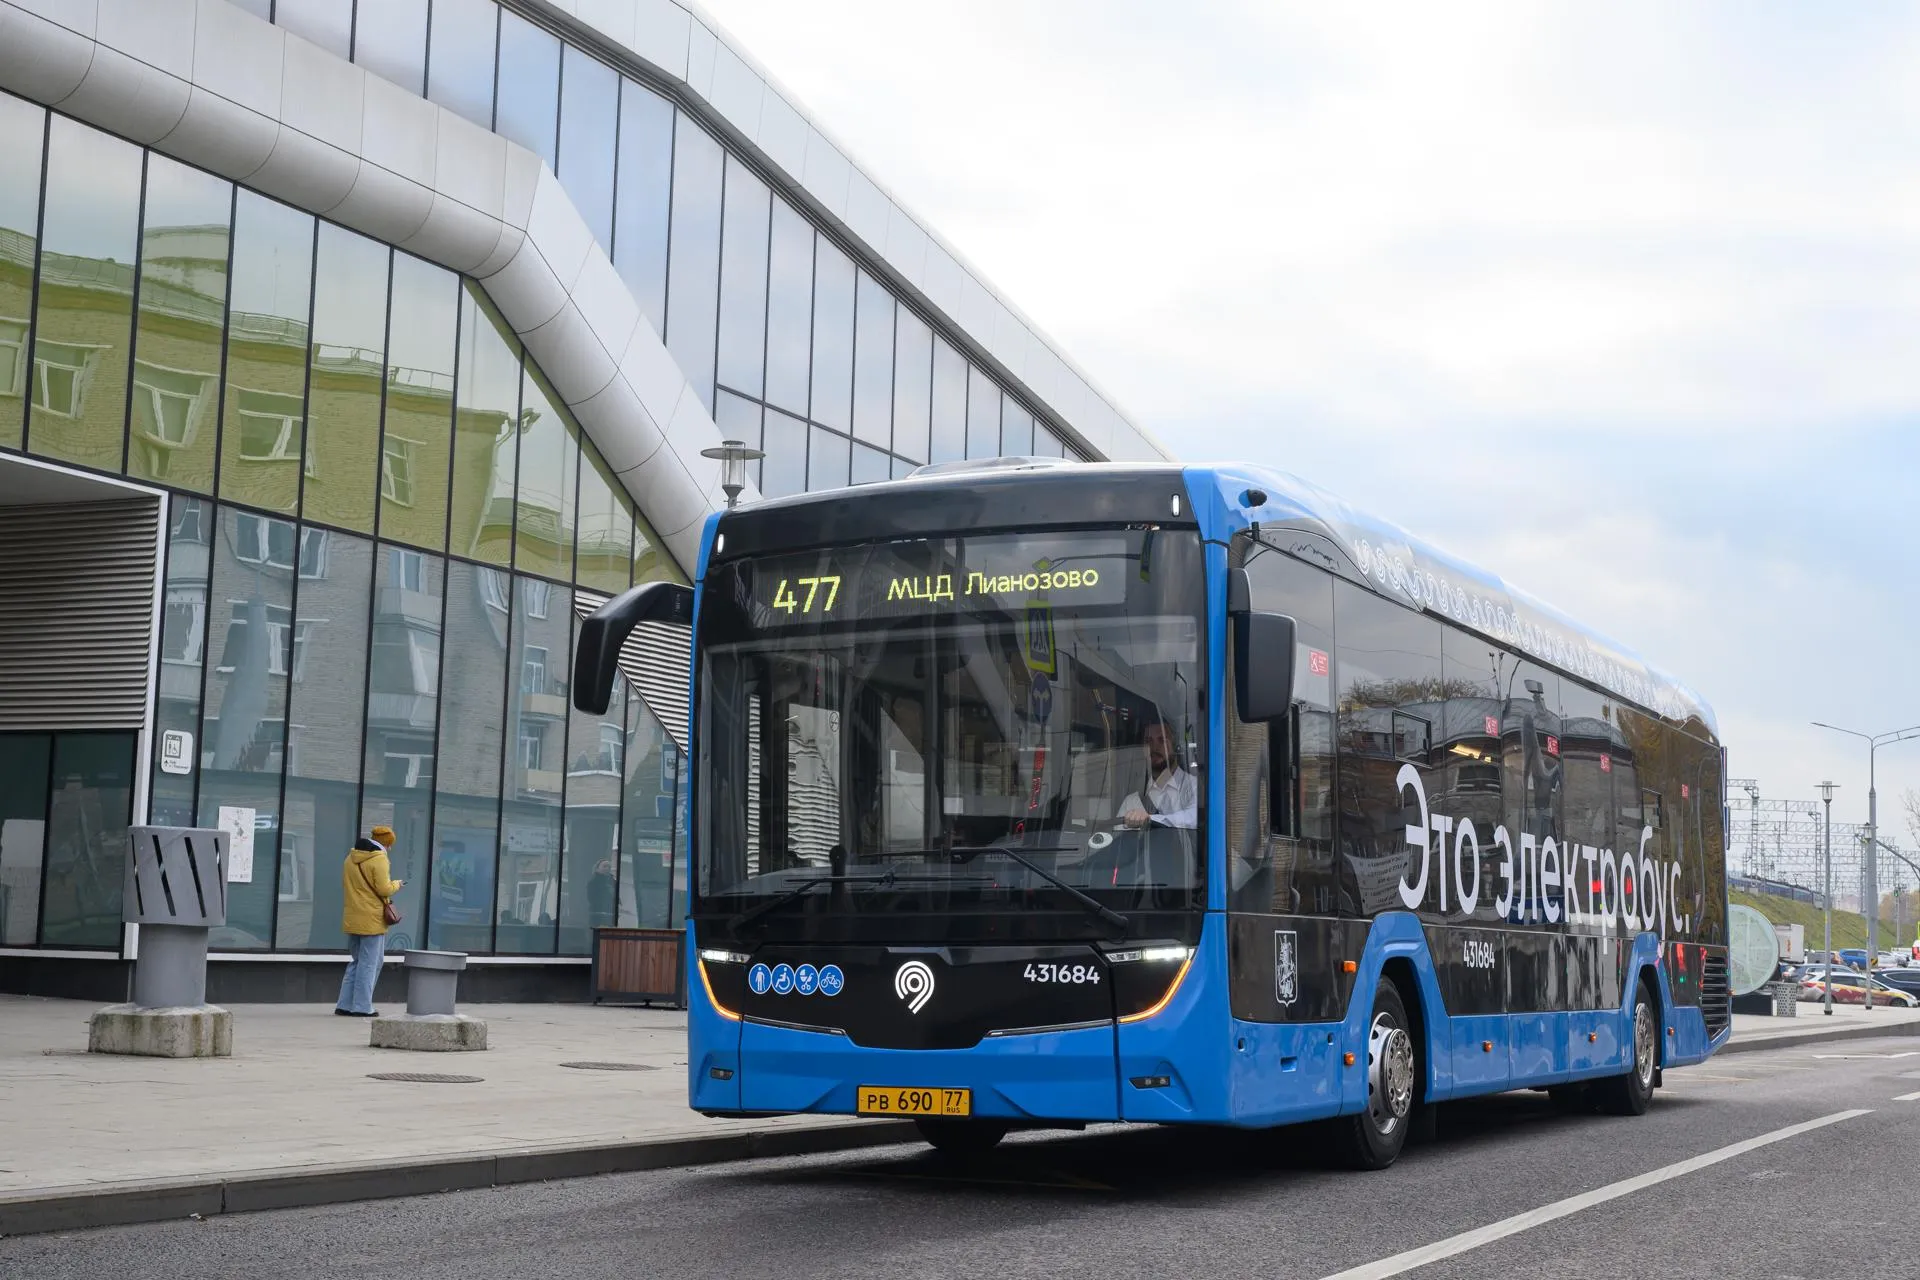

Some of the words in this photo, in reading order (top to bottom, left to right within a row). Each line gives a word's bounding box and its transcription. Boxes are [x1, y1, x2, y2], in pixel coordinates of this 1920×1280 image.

[773, 576, 841, 614] 477
[887, 574, 954, 602] МЦД
[964, 569, 1098, 595] Лианозово
[1396, 763, 1480, 915] Это
[1494, 825, 1690, 958] электробус.
[1463, 940, 1495, 968] 431684
[1023, 963, 1100, 984] 431684
[898, 1090, 932, 1111] 690
[944, 1091, 963, 1106] 77
